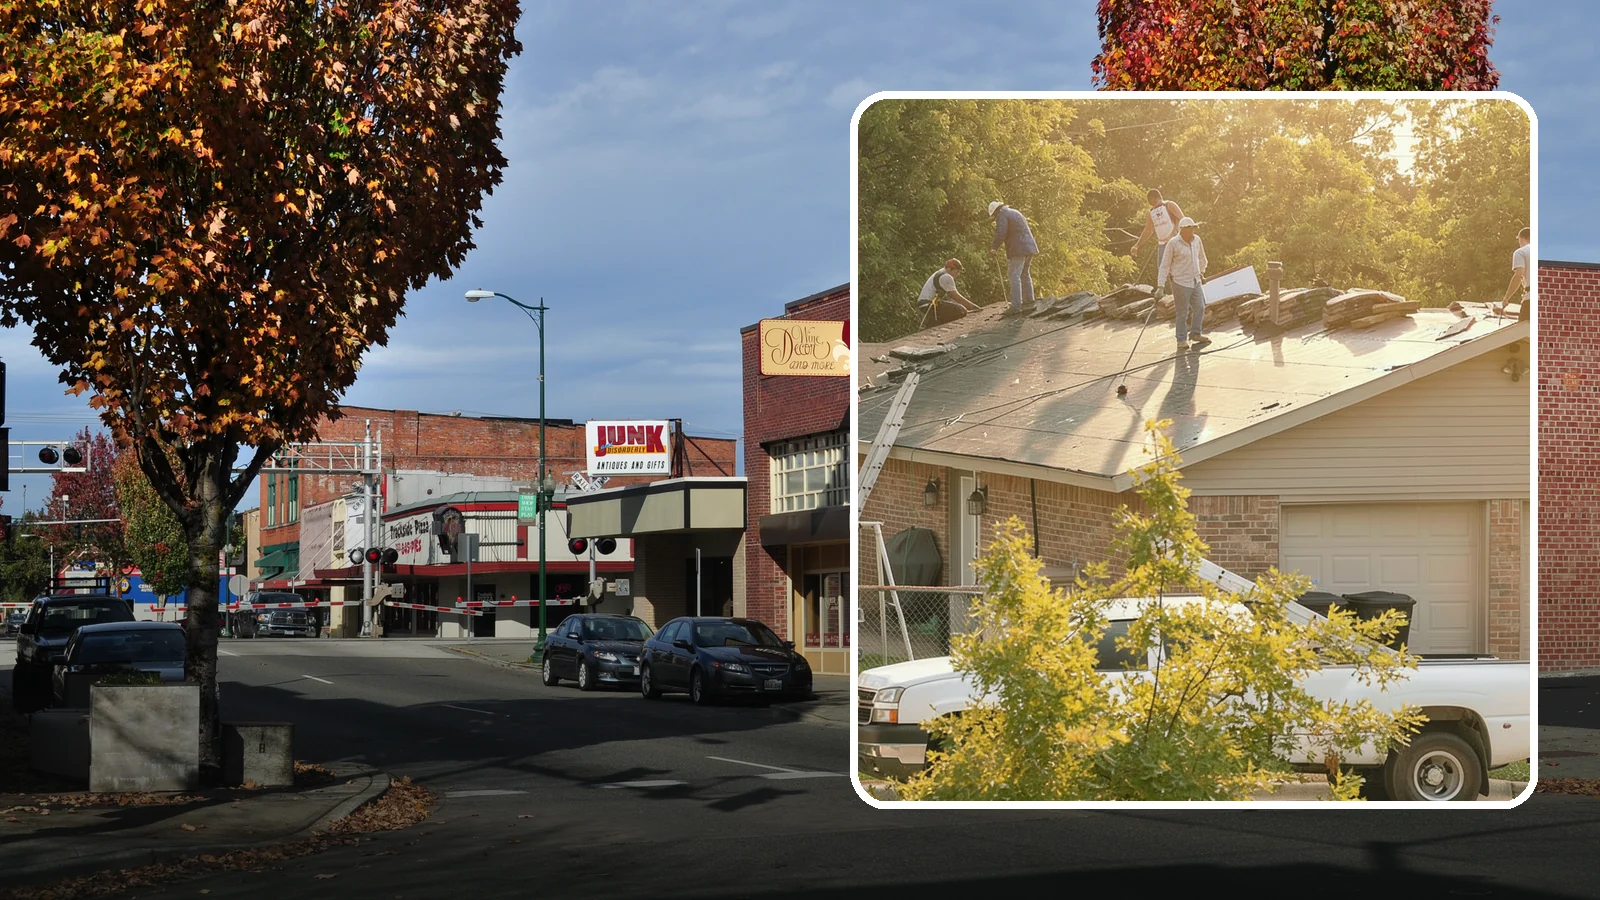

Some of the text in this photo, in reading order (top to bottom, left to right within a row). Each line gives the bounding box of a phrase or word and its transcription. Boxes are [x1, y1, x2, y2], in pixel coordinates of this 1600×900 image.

[596, 425, 665, 457] JUNK
[597, 460, 665, 470] ANTIQUES AND GIFTS
[573, 473, 588, 491] RAIL
[390, 519, 429, 539] Trackside Pizza
